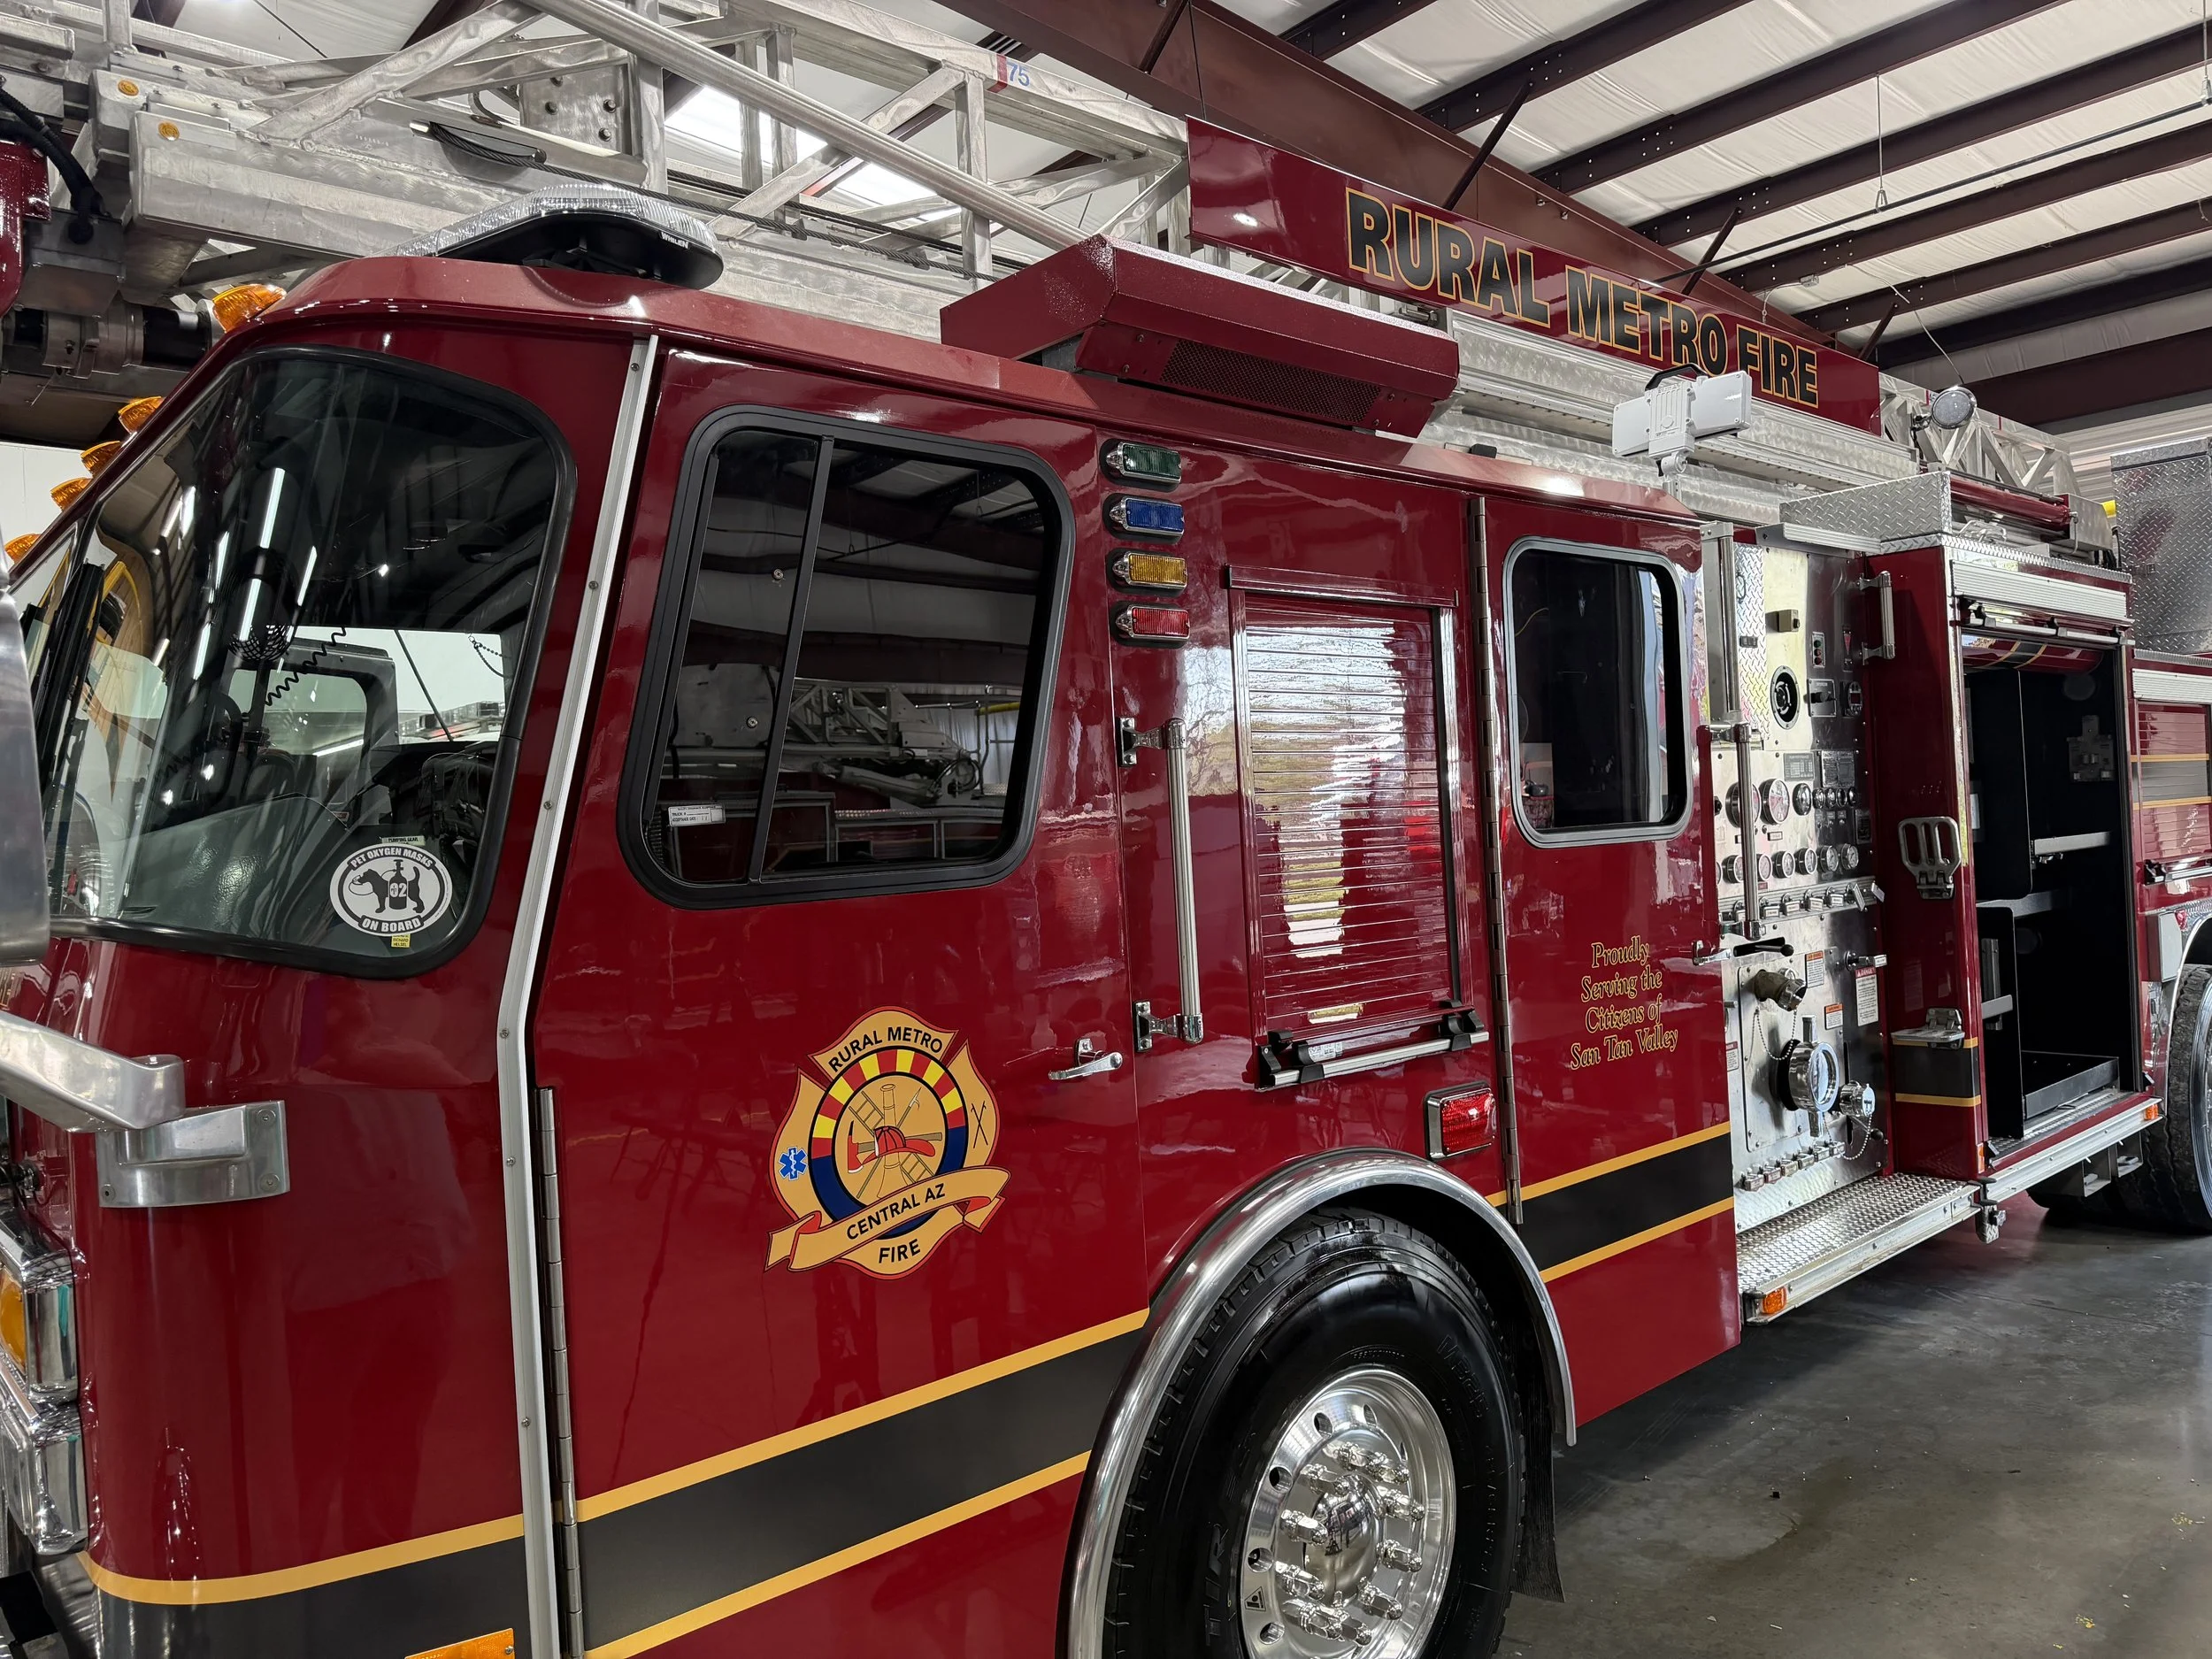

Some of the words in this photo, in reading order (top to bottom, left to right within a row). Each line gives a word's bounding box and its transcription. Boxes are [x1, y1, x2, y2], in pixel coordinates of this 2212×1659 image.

[1006, 61, 1030, 87] 75
[1346, 187, 1550, 328] RURAL
[1565, 265, 1728, 376] METRO
[1736, 322, 1819, 409] FIRE
[349, 855, 365, 867] PET
[367, 847, 402, 859] OXYGEN
[403, 849, 434, 867] MASKS
[362, 918, 379, 931] ON
[381, 918, 421, 932] BOARD
[1592, 935, 1650, 968] Proudly
[1581, 972, 1637, 1002] Serving
[1640, 964, 1663, 990] the
[1586, 1004, 1644, 1033] Citizens
[1648, 993, 1662, 1024] of
[828, 1030, 882, 1072] RURAL
[887, 1026, 943, 1054] METRO
[1571, 1043, 1601, 1070] San
[1604, 1035, 1633, 1062] Tan
[1635, 1024, 1678, 1053] Valley
[847, 1194, 920, 1240] CENTRAL
[925, 1183, 946, 1201] AZ
[879, 1239, 921, 1263] FIRE
